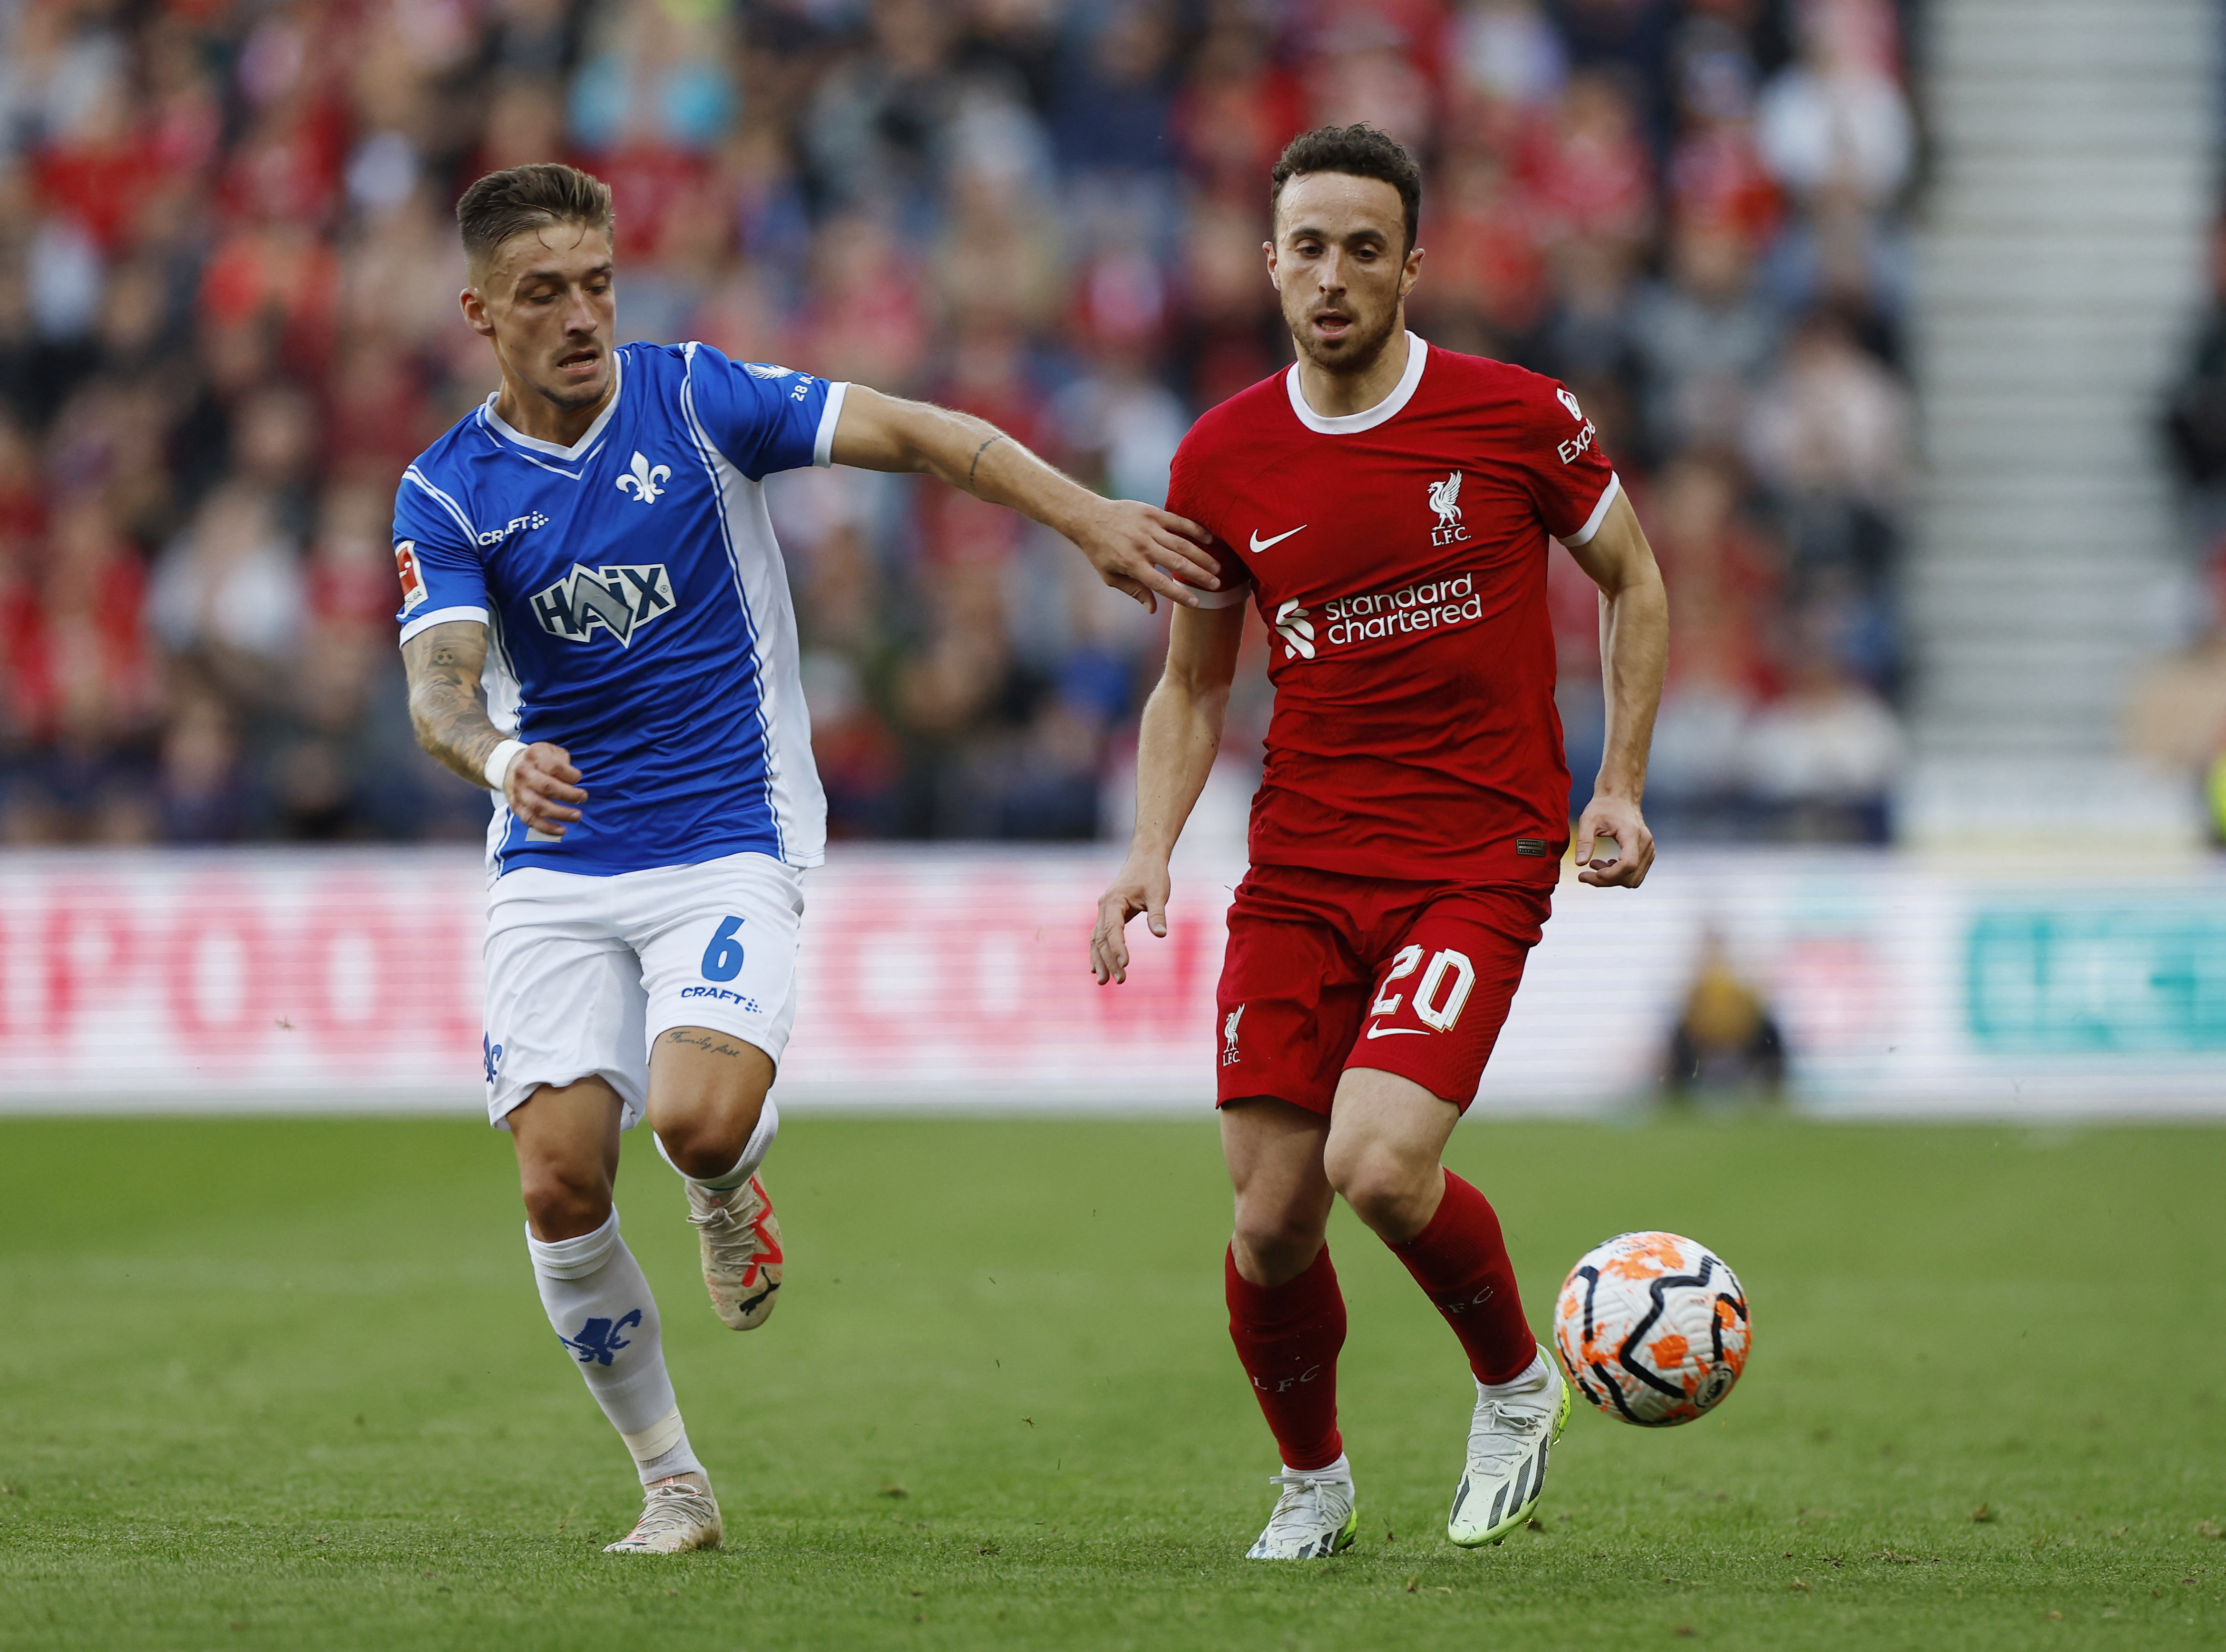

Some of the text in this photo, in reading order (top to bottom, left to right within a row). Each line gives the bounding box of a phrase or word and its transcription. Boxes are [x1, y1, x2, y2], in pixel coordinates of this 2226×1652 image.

[791, 372, 815, 402] 28 BL
[478, 516, 530, 546] CRAFT
[1431, 526, 1472, 547] L.F.C.
[1325, 572, 1473, 621] standard
[1328, 593, 1483, 645] chartered
[701, 915, 745, 982] 6
[681, 987, 747, 1005] CRAFT
[1370, 943, 1476, 1034] 20
[1222, 1050, 1241, 1067] L.F.C.
